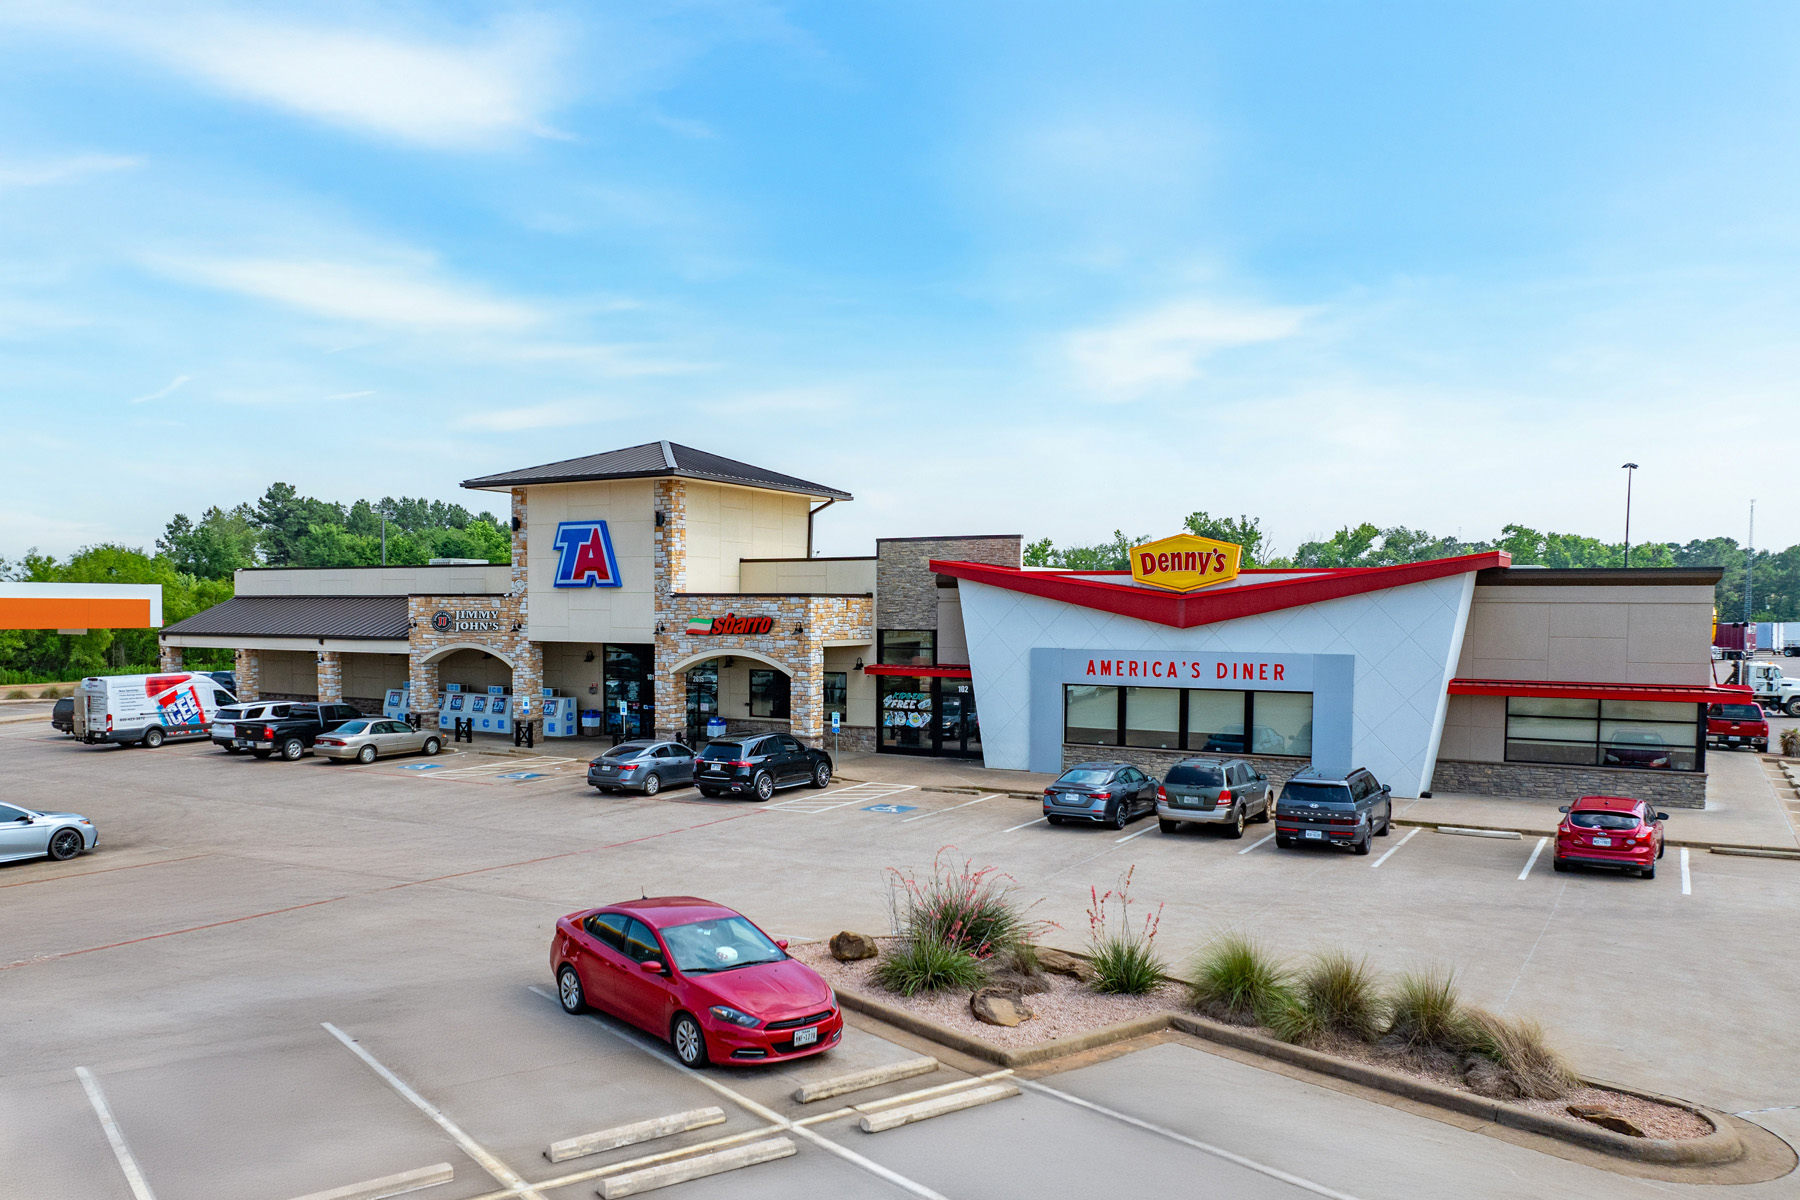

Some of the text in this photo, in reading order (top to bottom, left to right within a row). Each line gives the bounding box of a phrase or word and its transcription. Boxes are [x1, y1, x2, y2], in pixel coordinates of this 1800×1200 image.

[556, 523, 616, 585] TA
[1139, 547, 1227, 576] Denny's
[455, 610, 499, 620] JIMMY
[711, 612, 773, 635] sbarro
[455, 621, 499, 632] JOHN'S
[1086, 659, 1285, 681] AMERICA'S DINER
[957, 685, 969, 693] 102
[161, 691, 200, 726] ICEE
[890, 700, 917, 709] FREE
